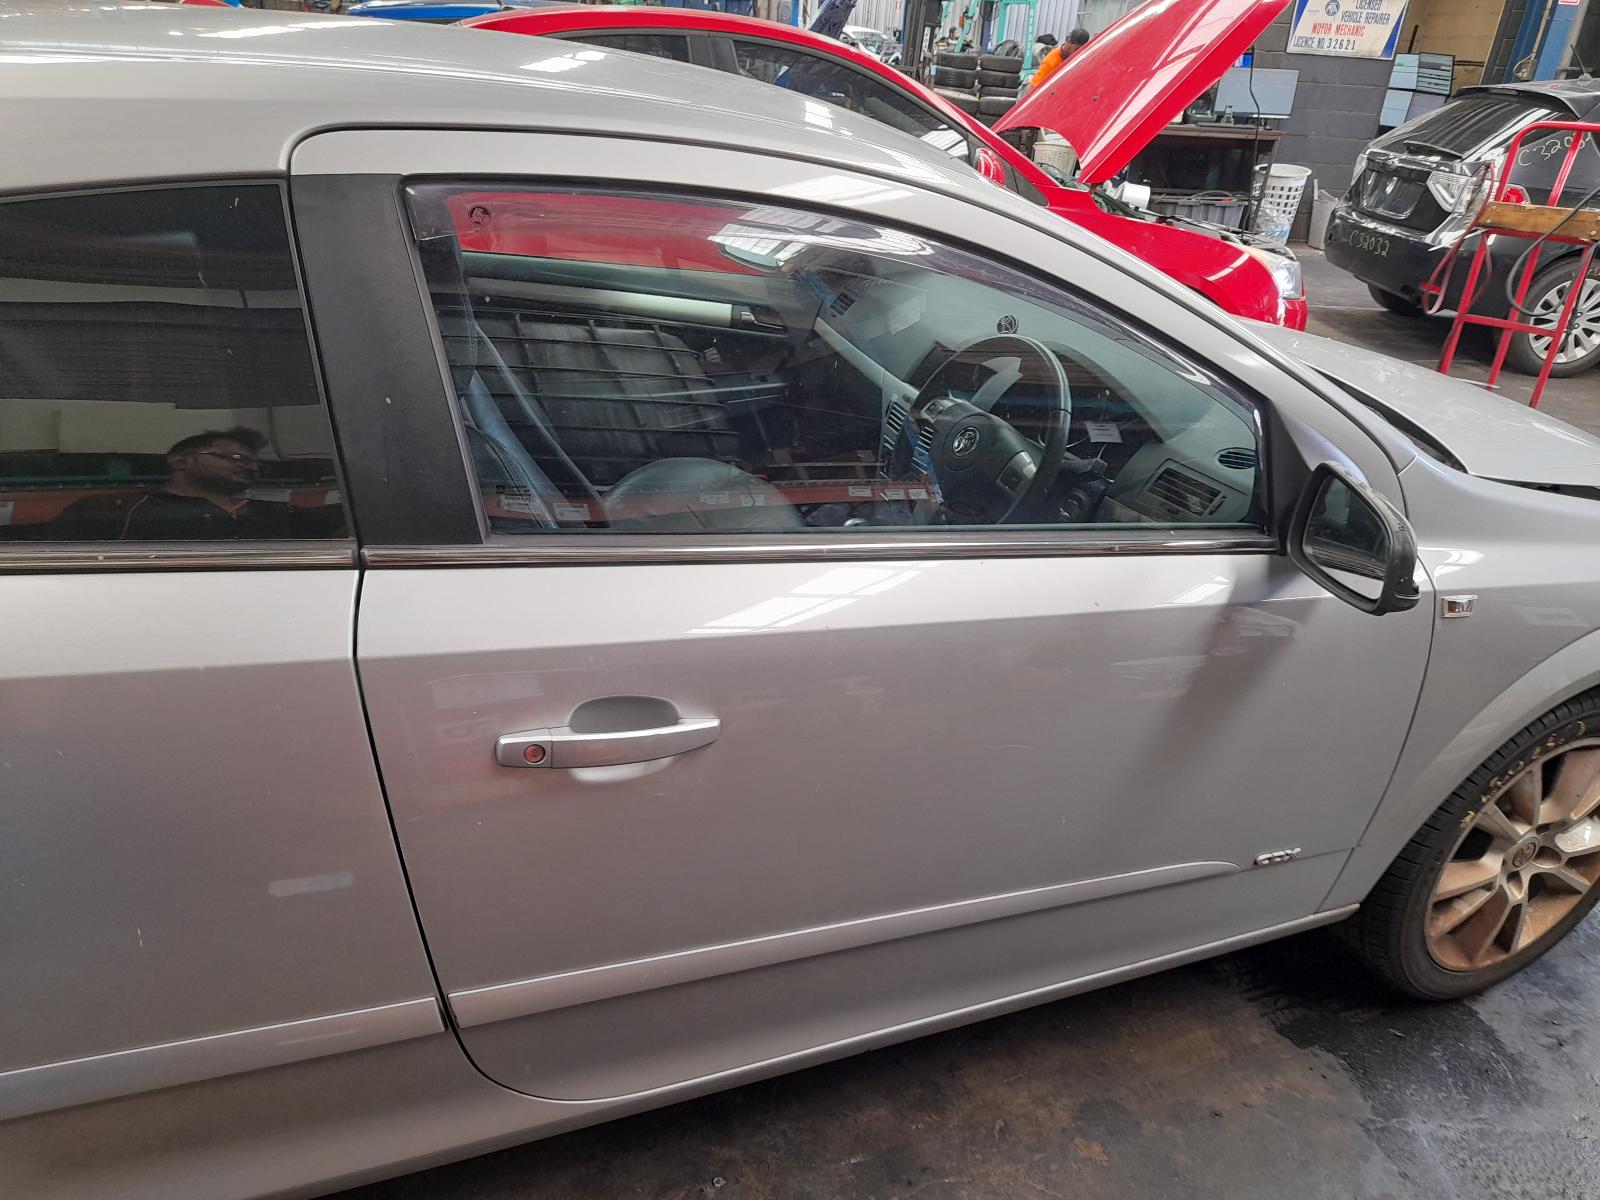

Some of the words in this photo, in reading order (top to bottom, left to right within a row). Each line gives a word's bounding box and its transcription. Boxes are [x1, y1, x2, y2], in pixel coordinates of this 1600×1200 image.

[1356, 0, 1382, 10] LICENSED
[1341, 11, 1363, 23] VEHICLE
[1365, 12, 1391, 25] REPAIRER
[1312, 22, 1332, 34] MOTOR
[1335, 24, 1366, 37] MECHANIC
[1293, 36, 1315, 48] LICENCE
[1350, 229, 1389, 257] C32032
